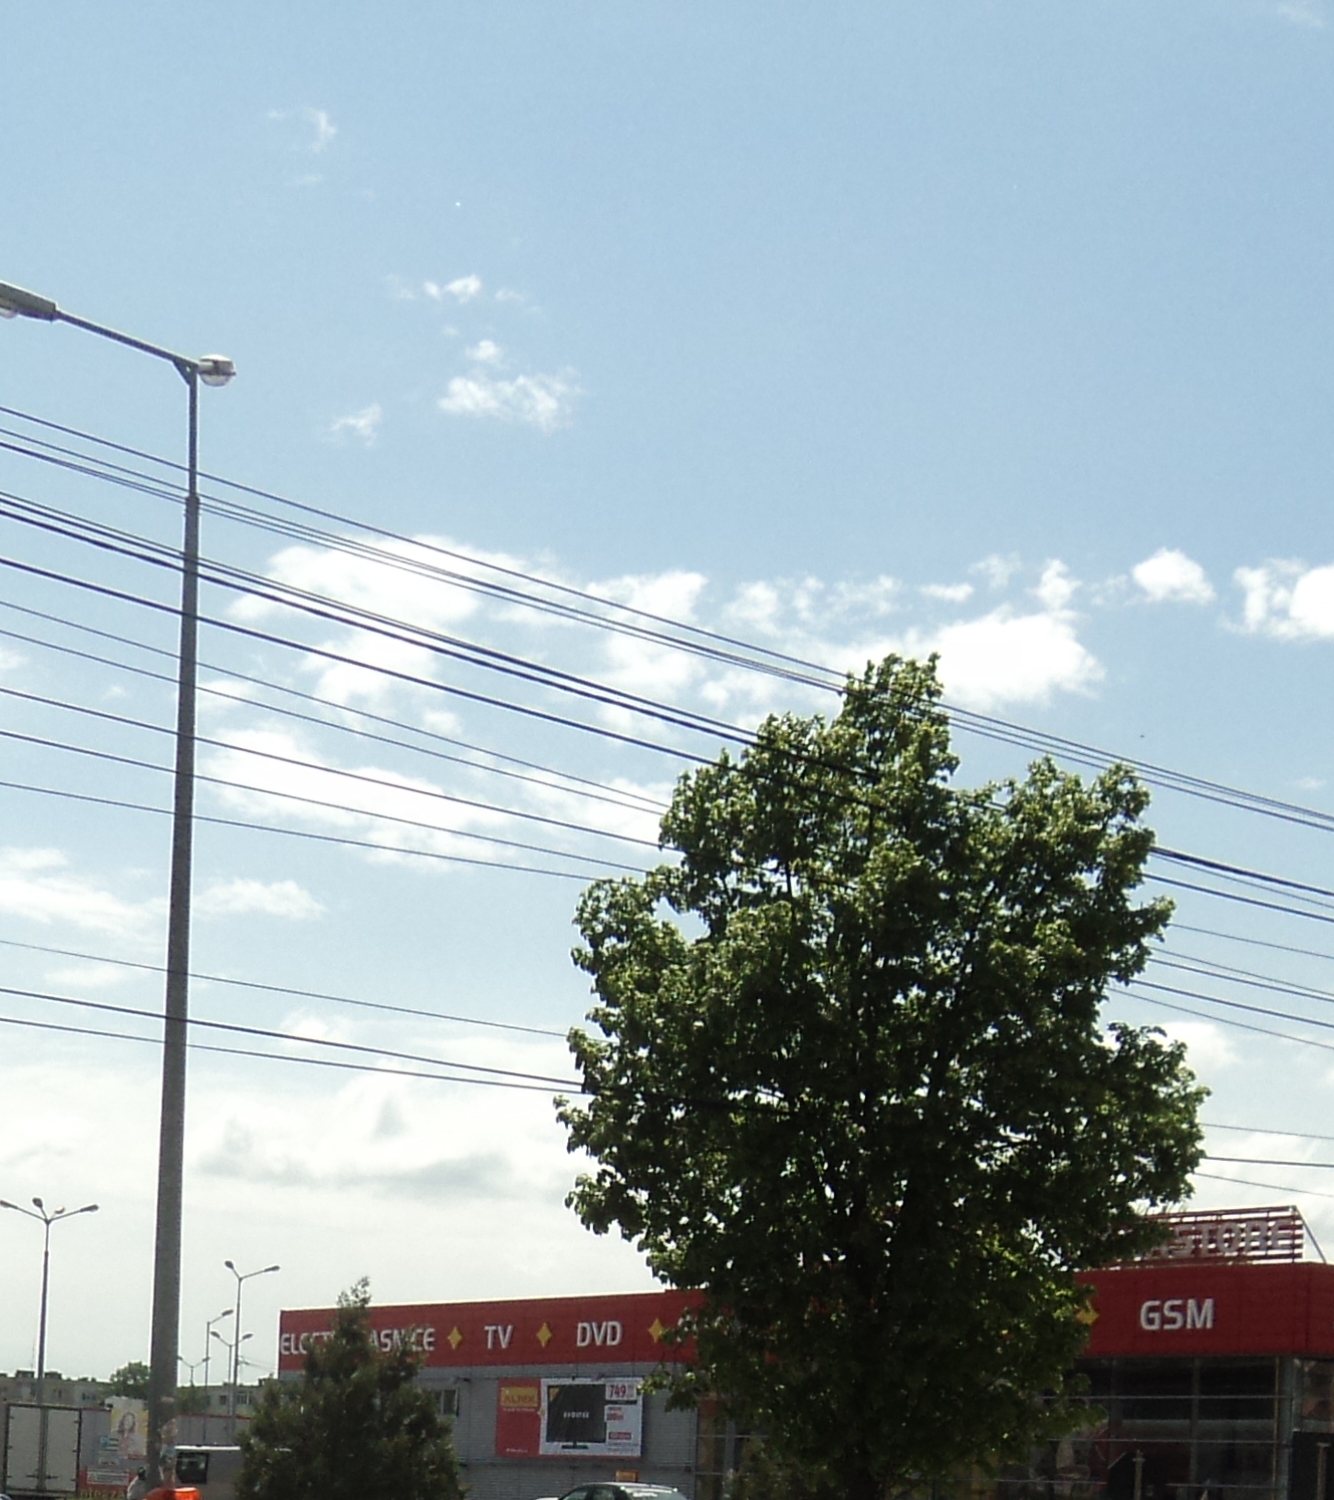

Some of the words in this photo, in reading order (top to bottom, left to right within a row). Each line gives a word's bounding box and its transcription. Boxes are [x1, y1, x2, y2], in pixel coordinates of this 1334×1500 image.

[1139, 1299, 1215, 1331] GSM
[484, 1325, 513, 1349] TV
[576, 1321, 622, 1347] DVD
